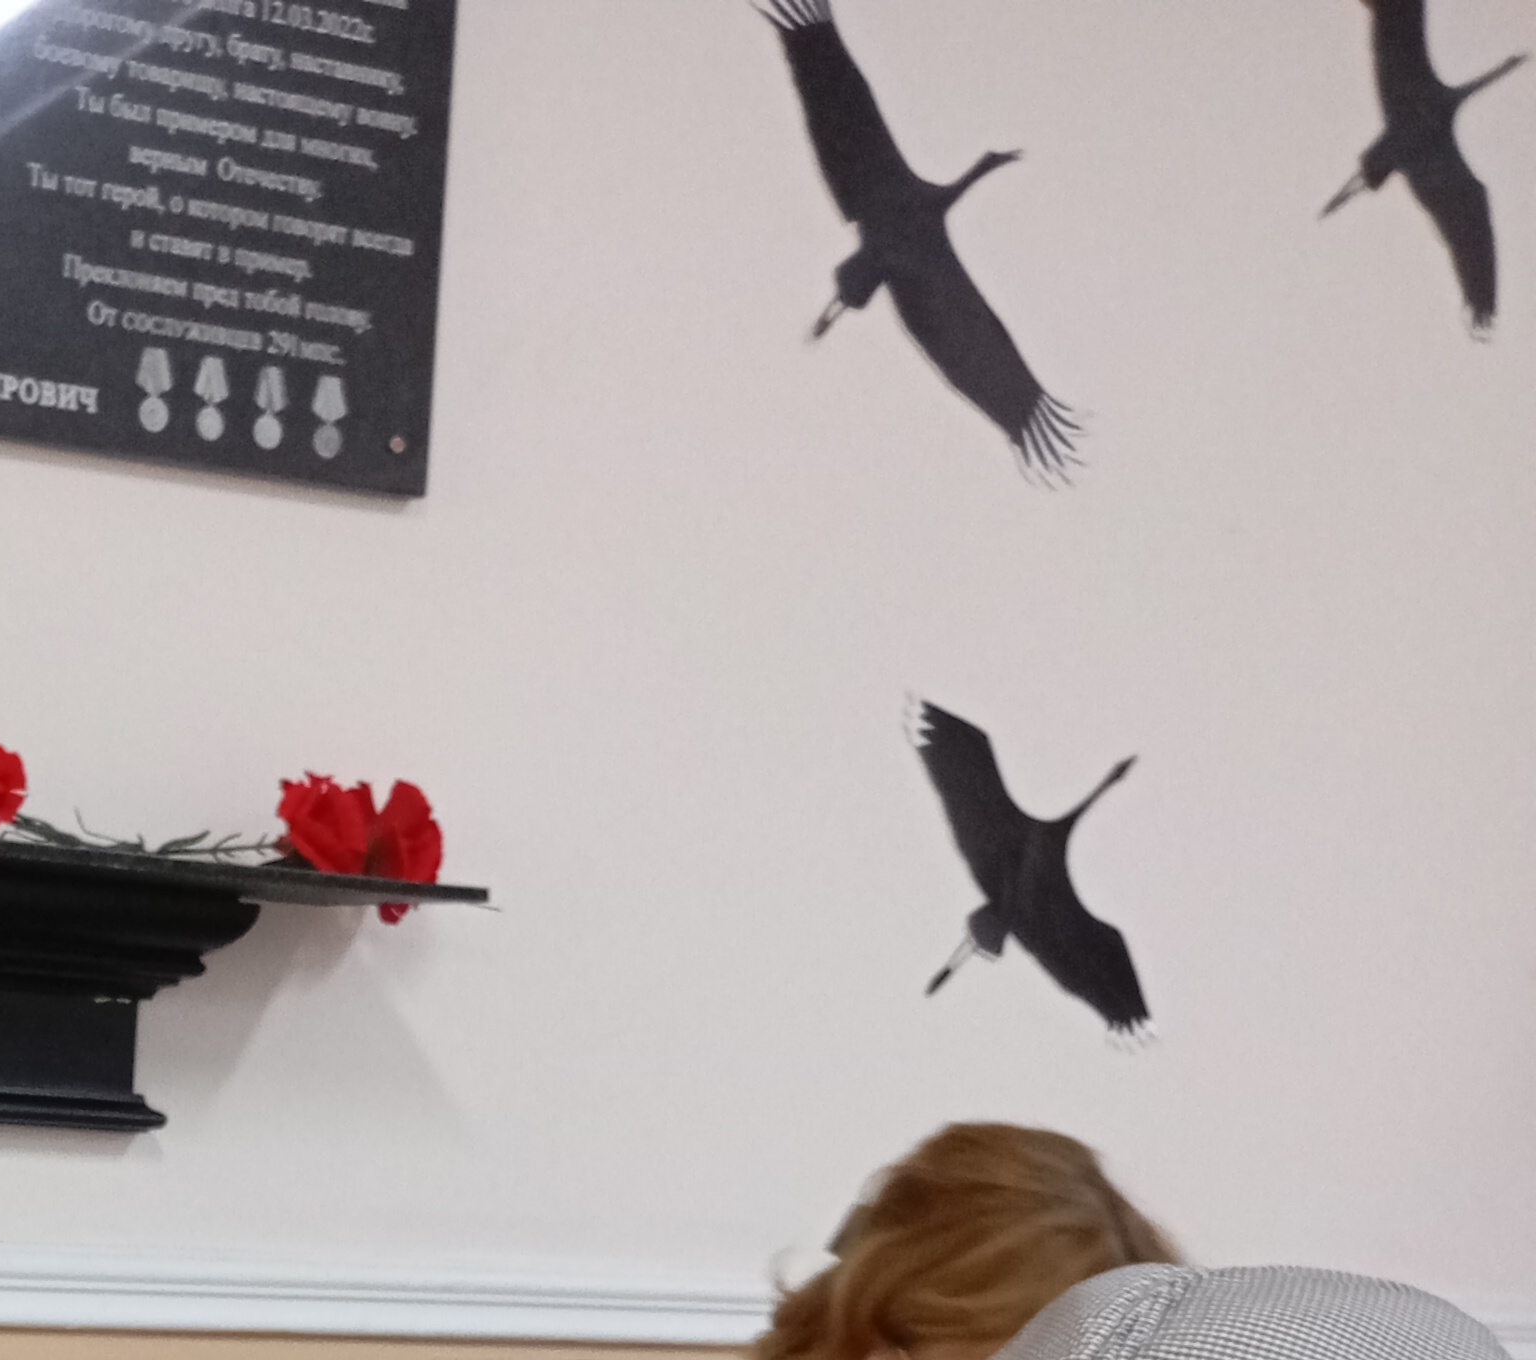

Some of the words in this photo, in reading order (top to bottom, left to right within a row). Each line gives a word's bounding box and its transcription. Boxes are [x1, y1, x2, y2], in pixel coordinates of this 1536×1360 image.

[75, 86, 105, 114] Ты
[109, 93, 152, 124] был
[26, 162, 59, 191] Ты
[169, 196, 184, 214] о
[87, 300, 119, 327] От
